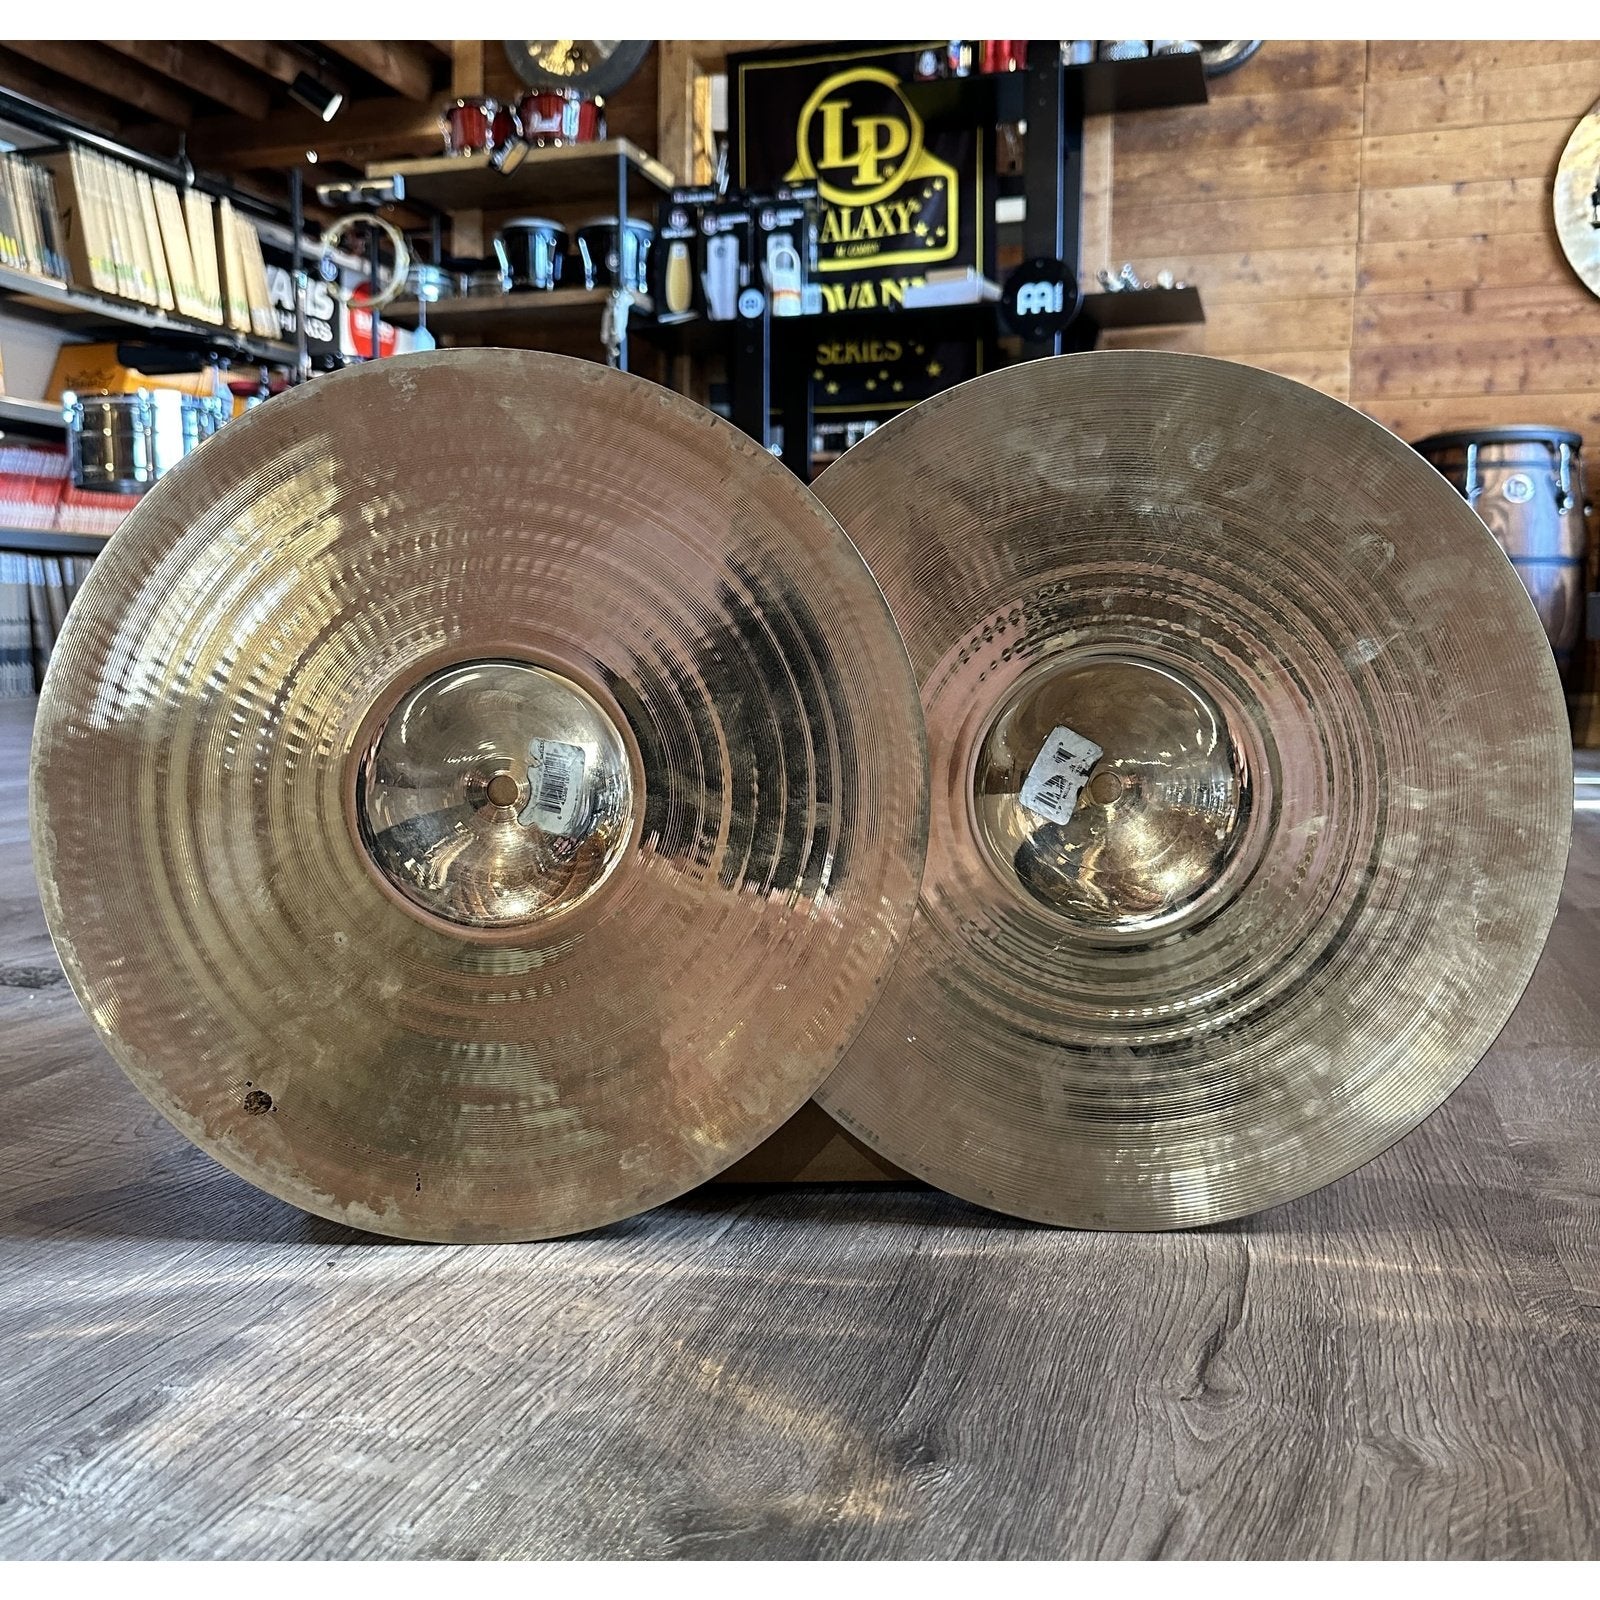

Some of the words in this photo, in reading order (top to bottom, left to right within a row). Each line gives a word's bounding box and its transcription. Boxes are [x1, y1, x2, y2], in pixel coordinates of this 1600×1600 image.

[817, 101, 910, 187] LP
[820, 201, 915, 244] ALAXY
[816, 340, 903, 365] SERIES
